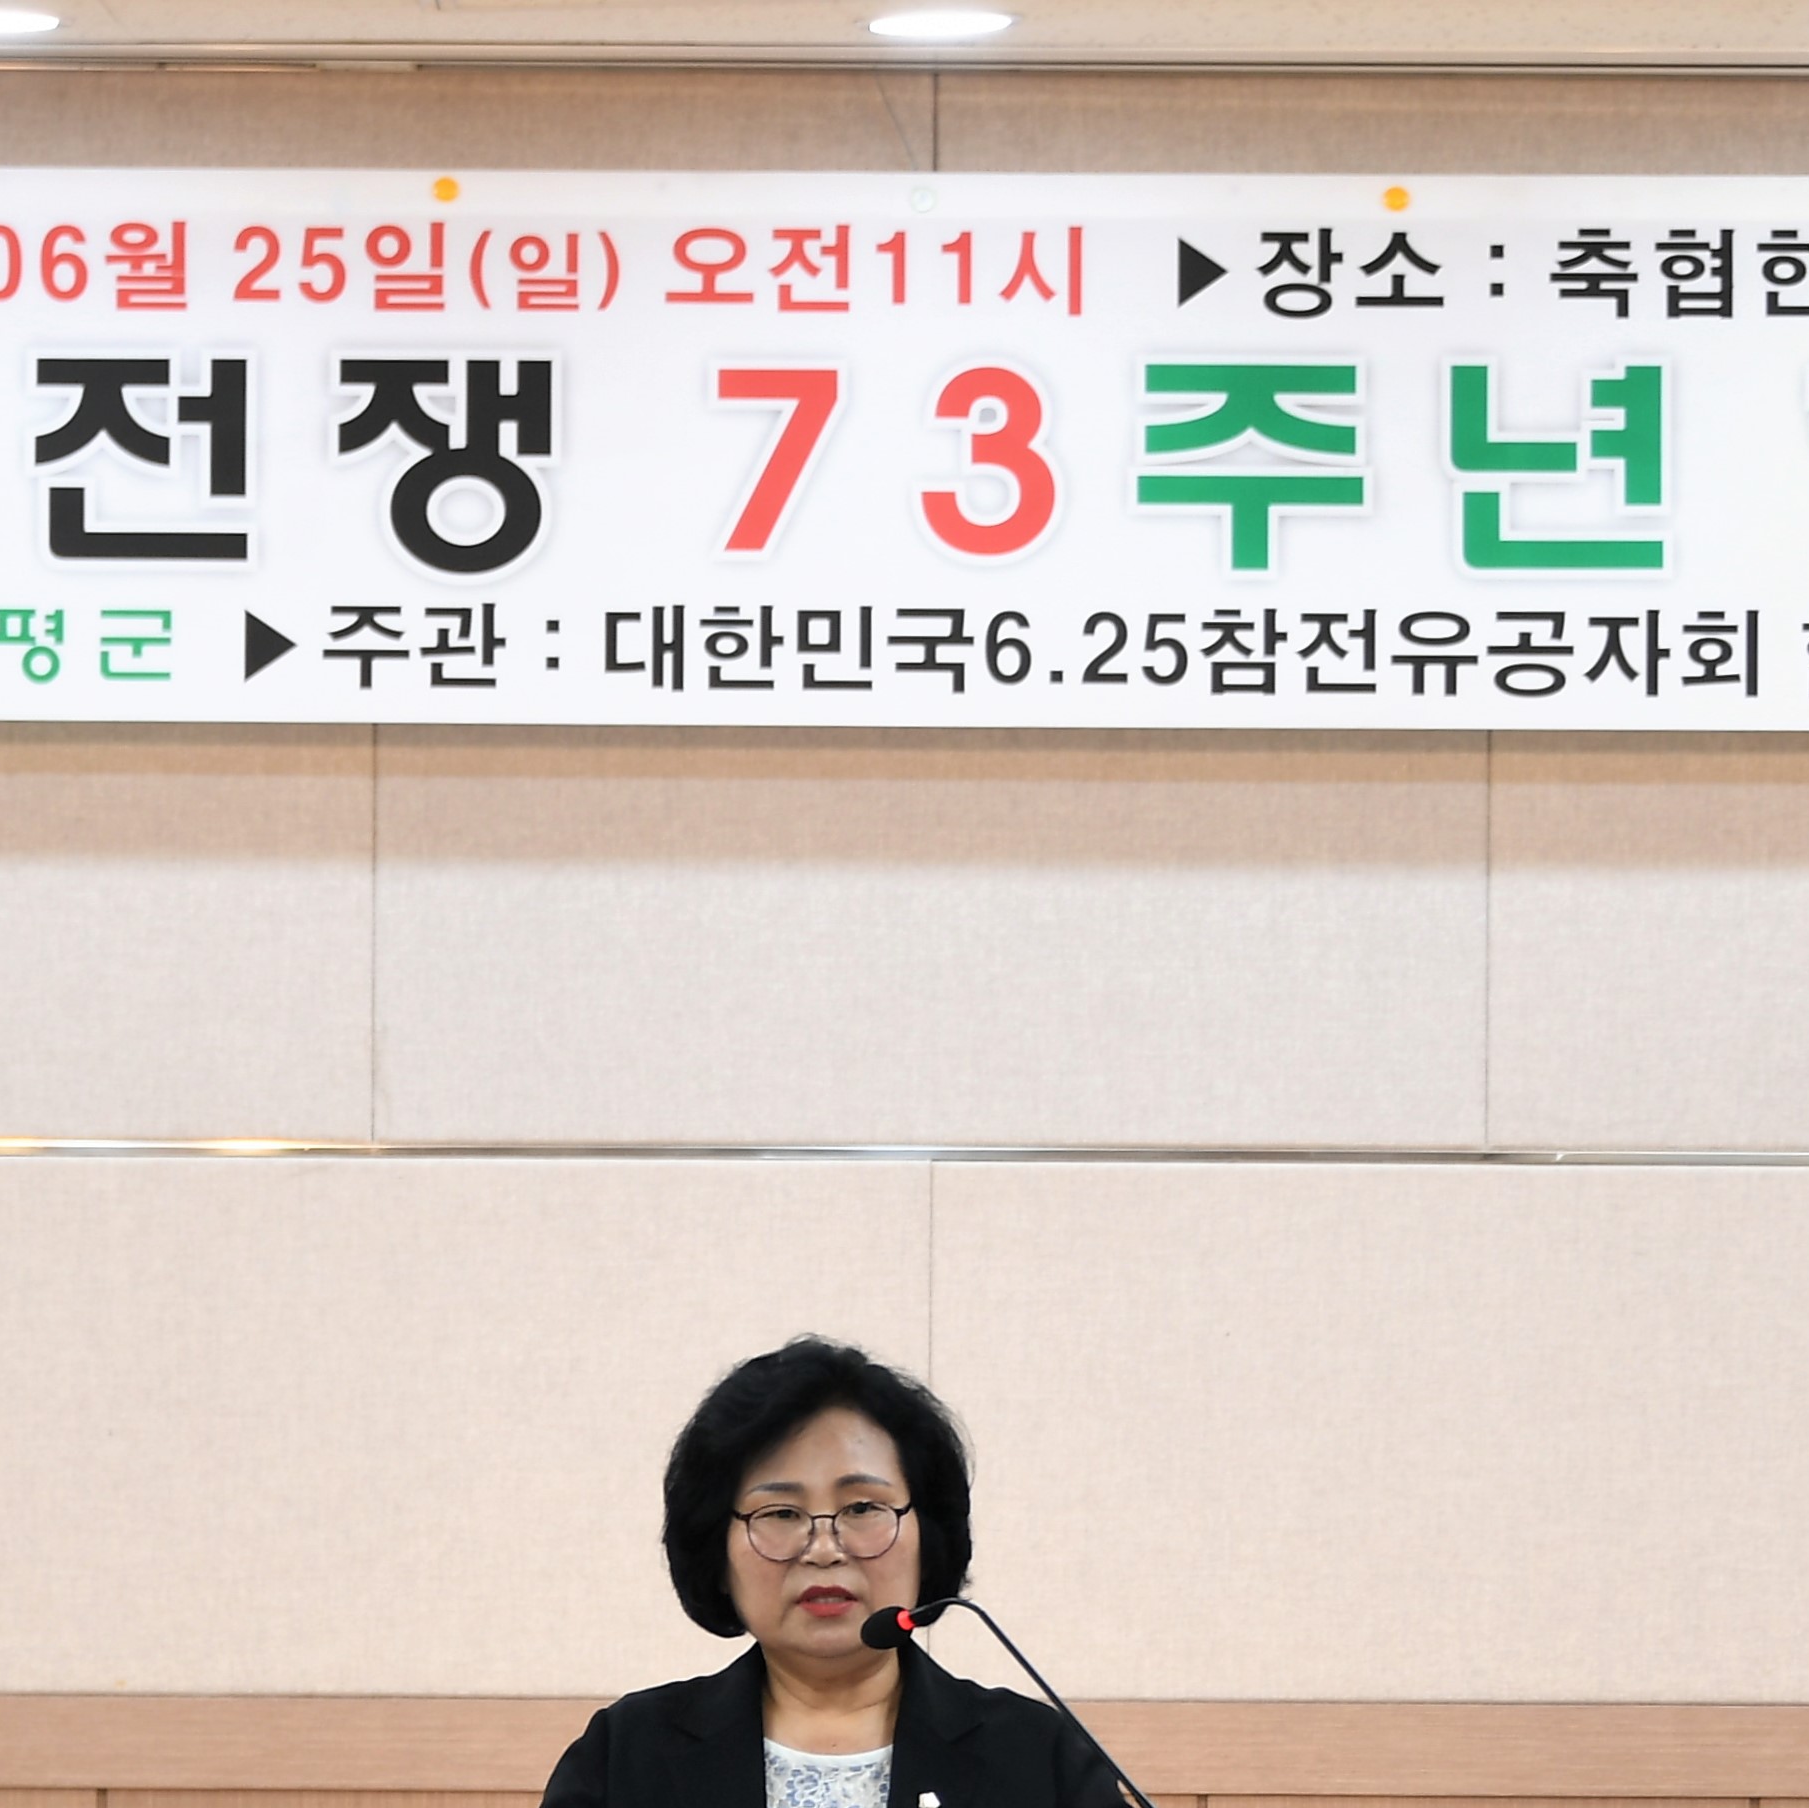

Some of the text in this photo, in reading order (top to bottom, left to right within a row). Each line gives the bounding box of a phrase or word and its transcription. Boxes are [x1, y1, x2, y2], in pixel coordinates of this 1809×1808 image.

[233, 220, 621, 312] 25일(일)
[665, 223, 1084, 317] 오전11시
[1256, 226, 1445, 319] 장소
[717, 362, 1666, 571] 73주년
[322, 602, 507, 689] 주관
[604, 603, 1760, 698] 대한민국6.25참전유공자회
